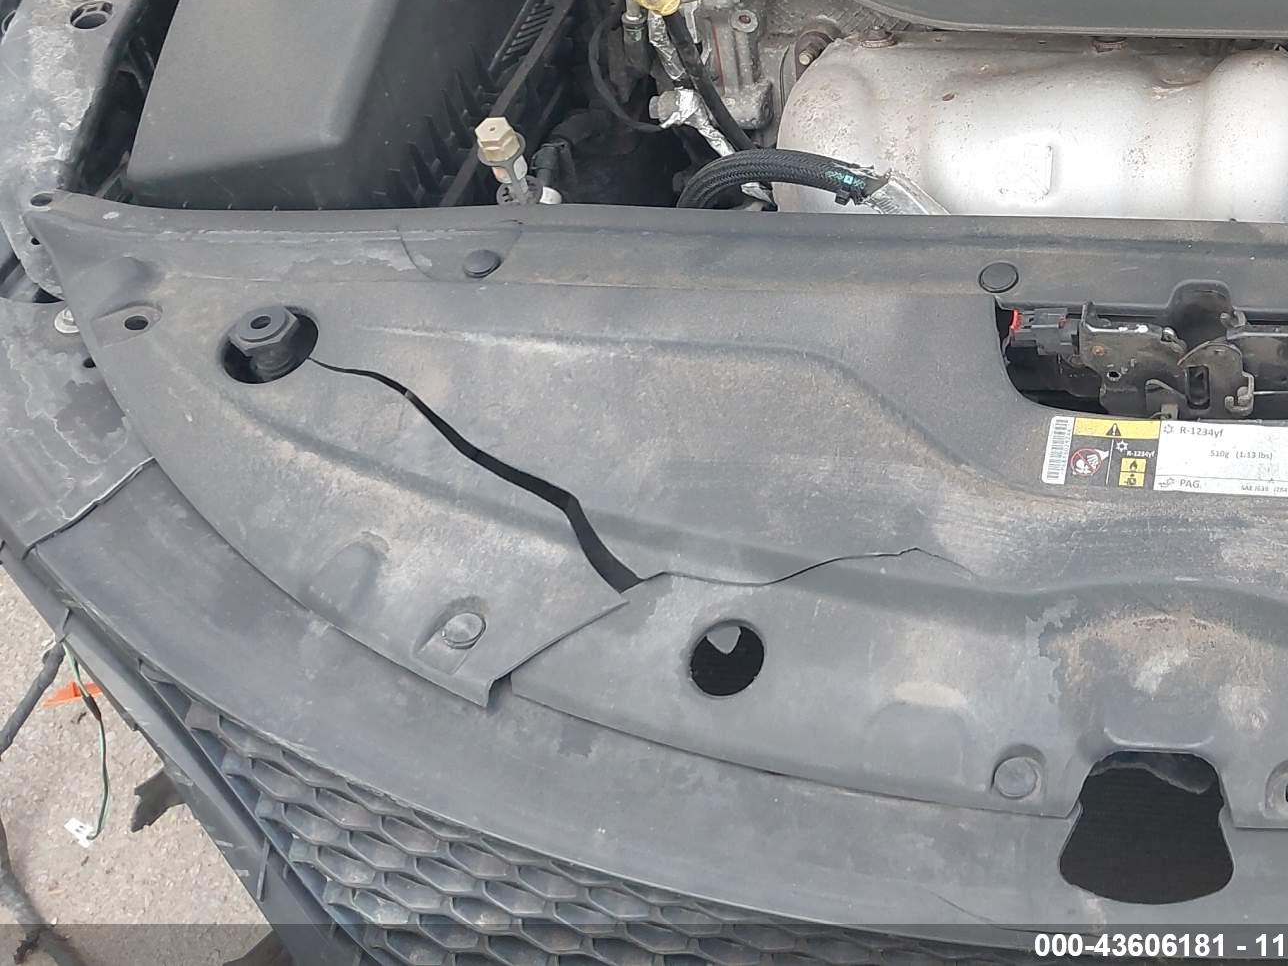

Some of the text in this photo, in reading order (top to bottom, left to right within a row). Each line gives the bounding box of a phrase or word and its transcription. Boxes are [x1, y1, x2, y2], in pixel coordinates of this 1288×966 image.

[1179, 427, 1223, 438] R-1234yf
[1126, 450, 1155, 458] R-1234yf
[1179, 479, 1200, 489] PAG
